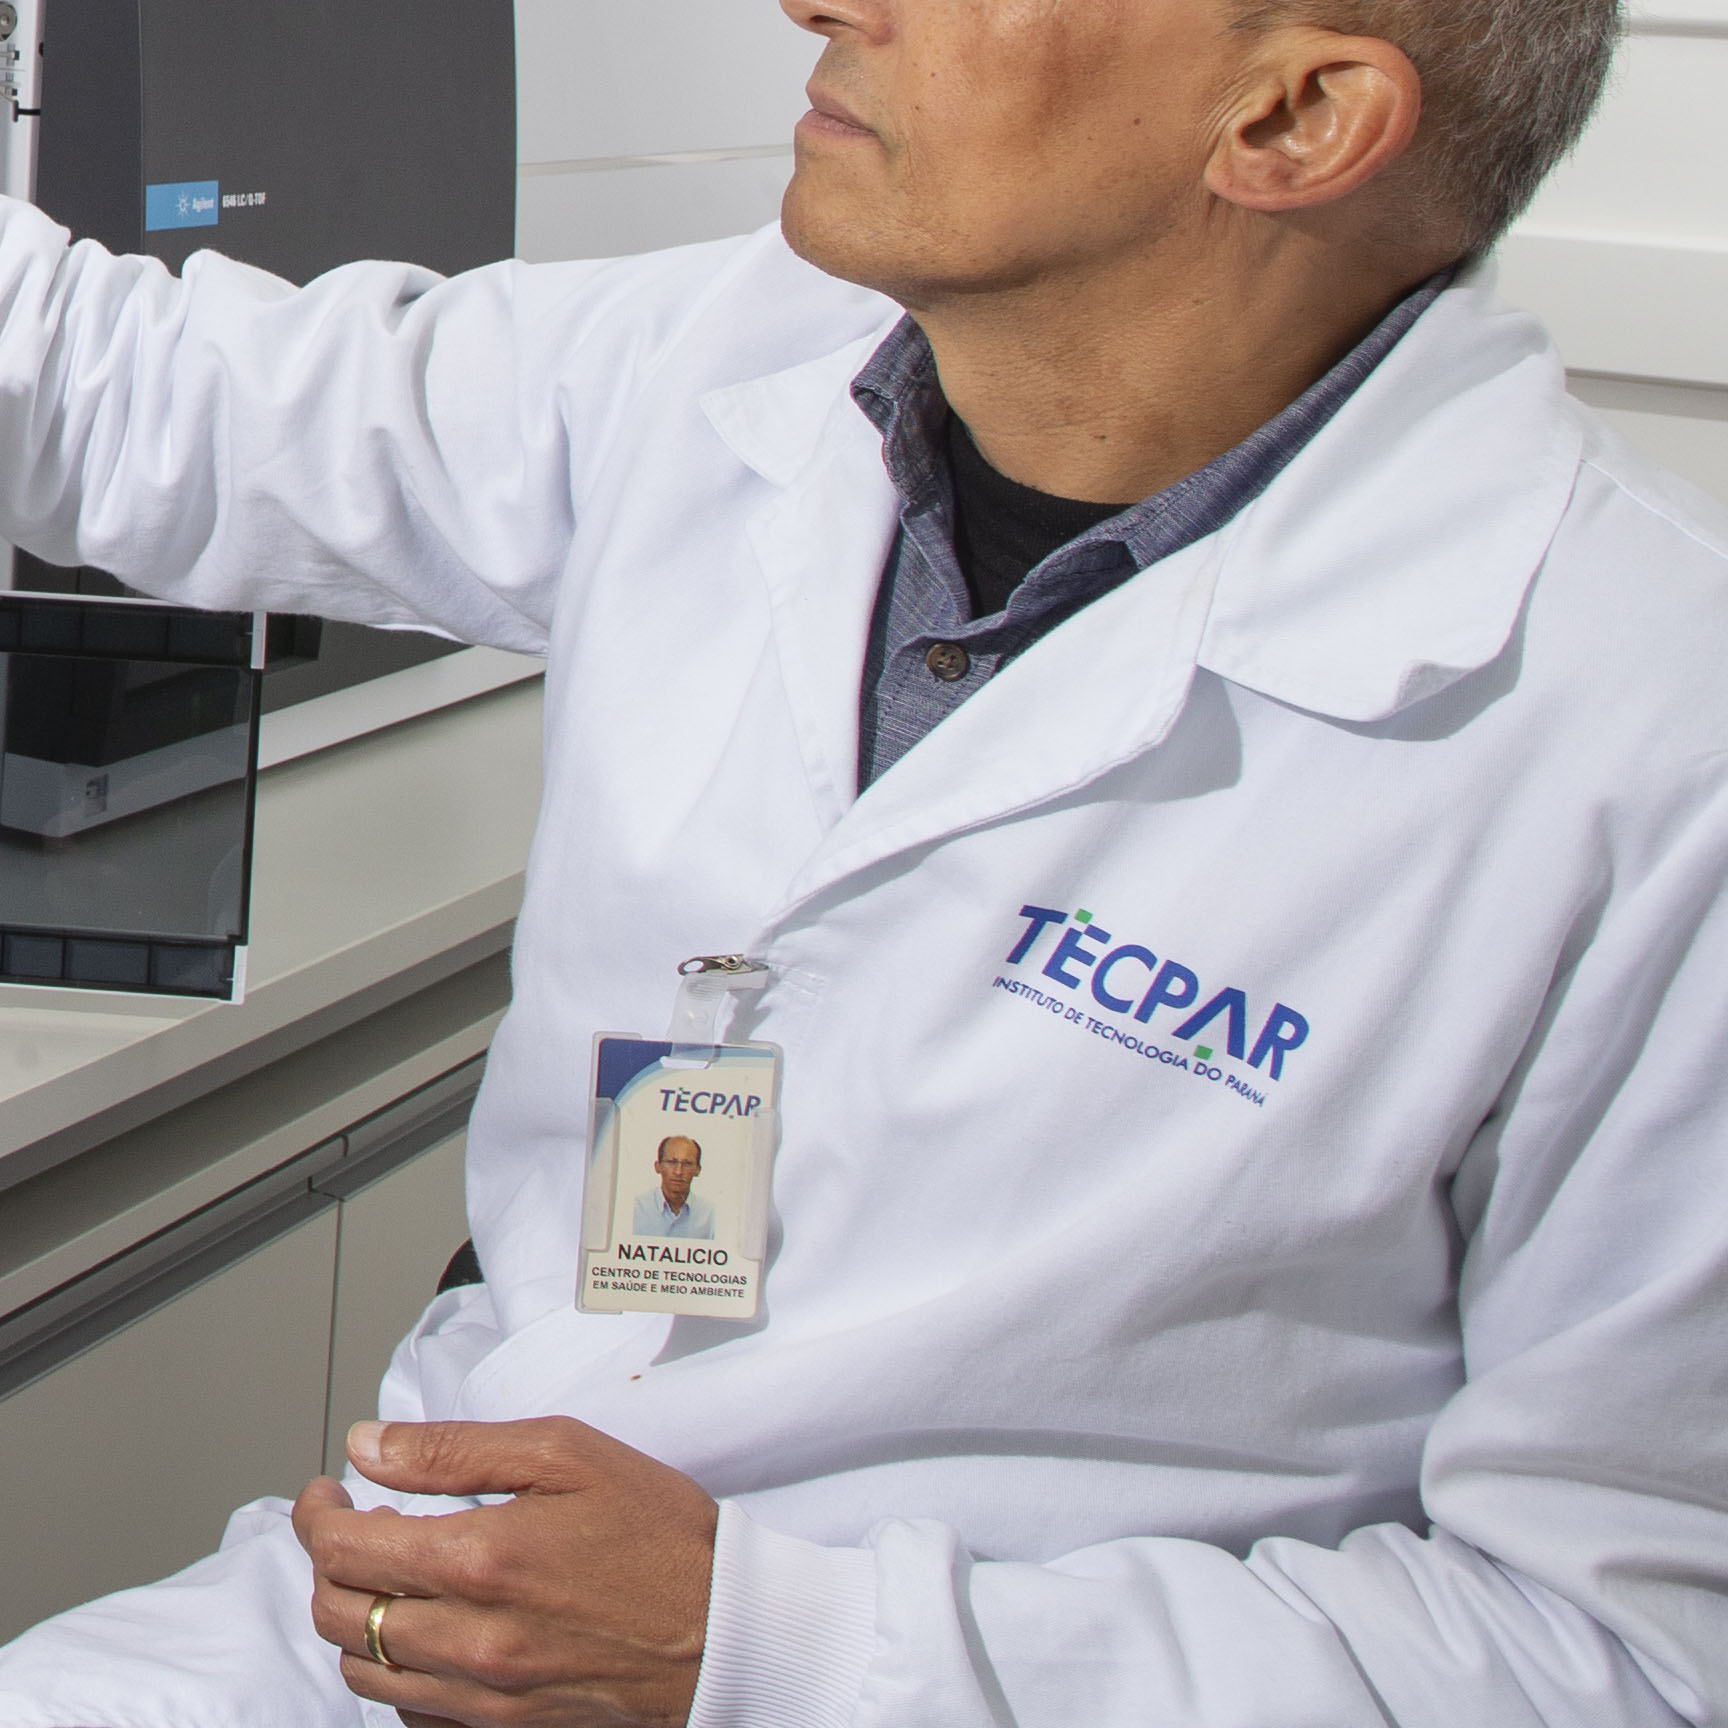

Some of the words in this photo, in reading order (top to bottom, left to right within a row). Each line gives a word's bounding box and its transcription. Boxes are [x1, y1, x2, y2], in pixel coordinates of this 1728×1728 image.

[1005, 904, 1310, 1082] TECPAR
[992, 975, 1064, 1015] INSTITUTO
[1064, 1006, 1084, 1024] DE
[1083, 1016, 1189, 1071] TECNOLOGIA
[1193, 1060, 1223, 1081] DO
[1224, 1073, 1269, 1108] PARANÁ
[659, 1086, 762, 1119] TECPAR
[617, 1243, 729, 1266] NATALICIO
[591, 1266, 640, 1279] CENTRO
[643, 1270, 659, 1280] DE
[663, 1271, 748, 1286] TECNOLOGIAS
[593, 1280, 609, 1290] EM
[610, 1279, 647, 1292] SAÚDE
[650, 1283, 657, 1293] E
[660, 1284, 688, 1295] MEIO
[689, 1286, 745, 1299] AMBIENTE
